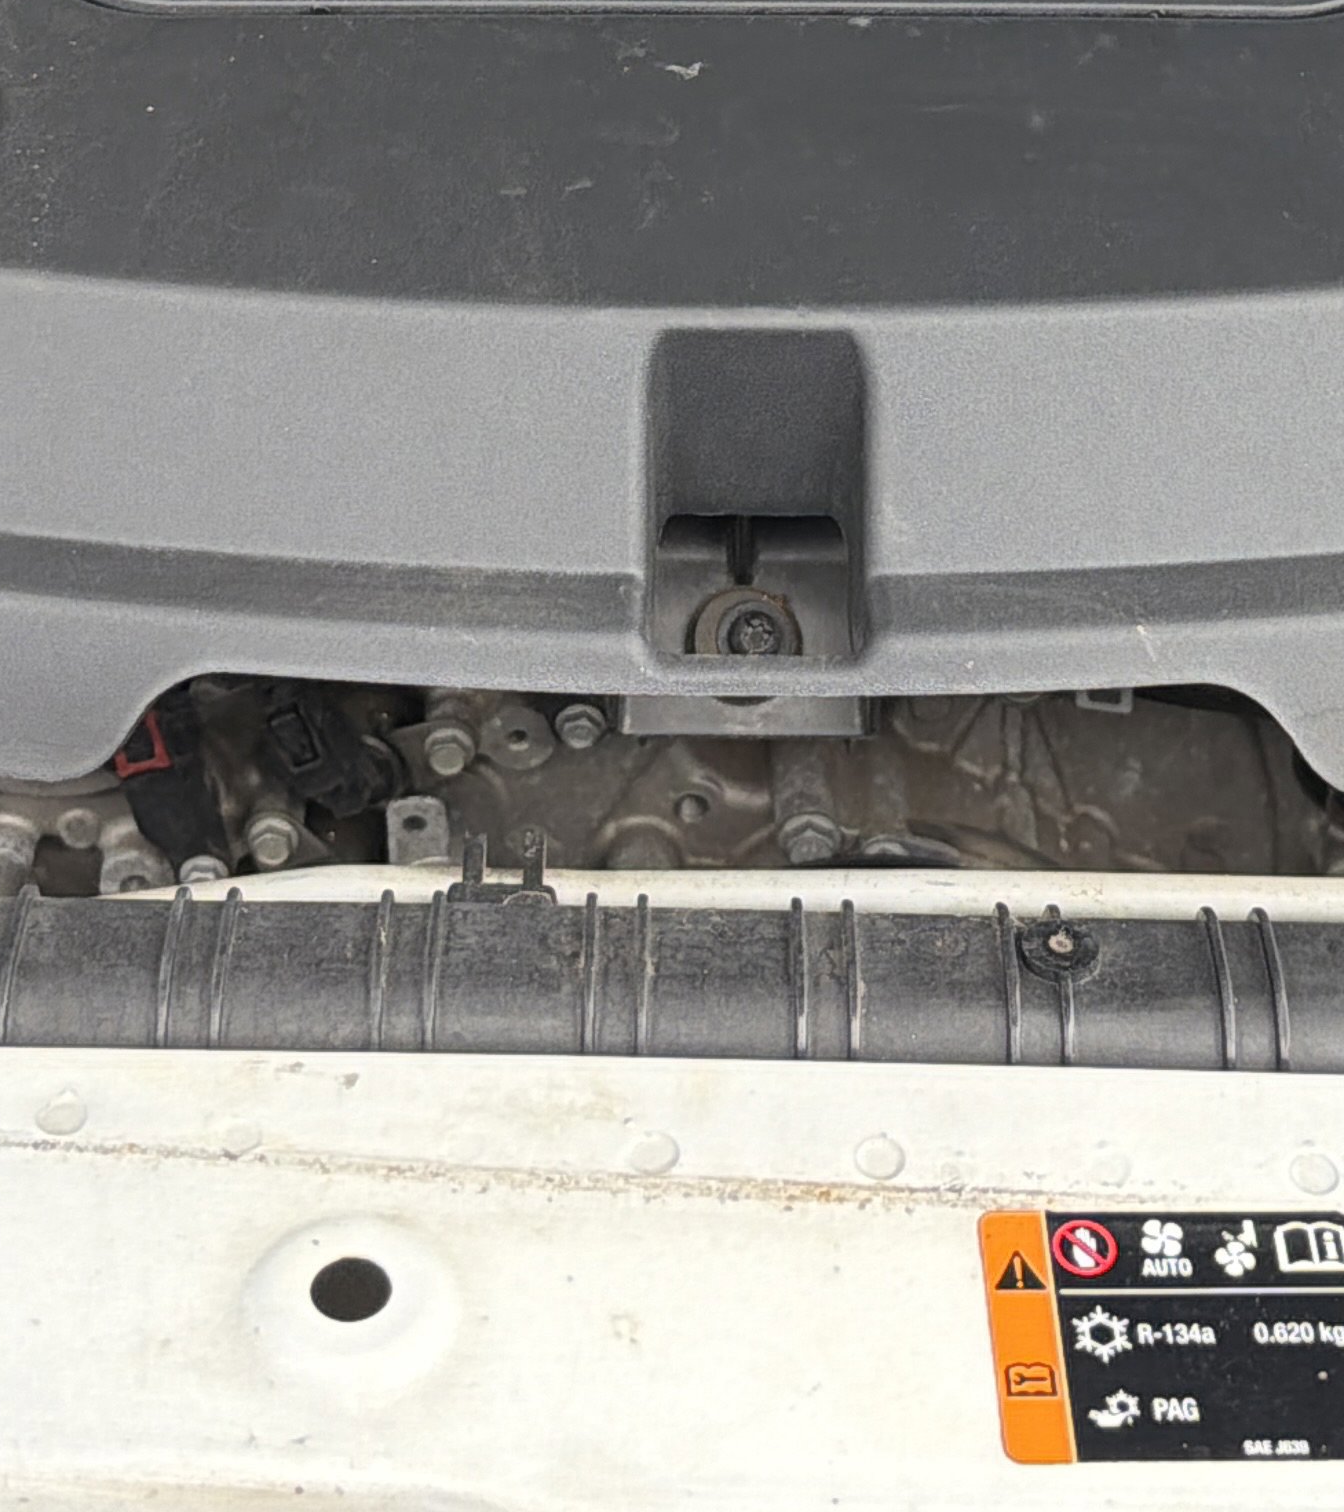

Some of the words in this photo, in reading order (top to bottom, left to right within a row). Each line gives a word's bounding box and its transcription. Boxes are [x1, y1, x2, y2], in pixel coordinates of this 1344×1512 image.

[1142, 1257, 1194, 1277] AUTO
[1136, 1321, 1217, 1345] R-134a
[1253, 1321, 1315, 1345] 0.620
[1152, 1396, 1200, 1423] PAG
